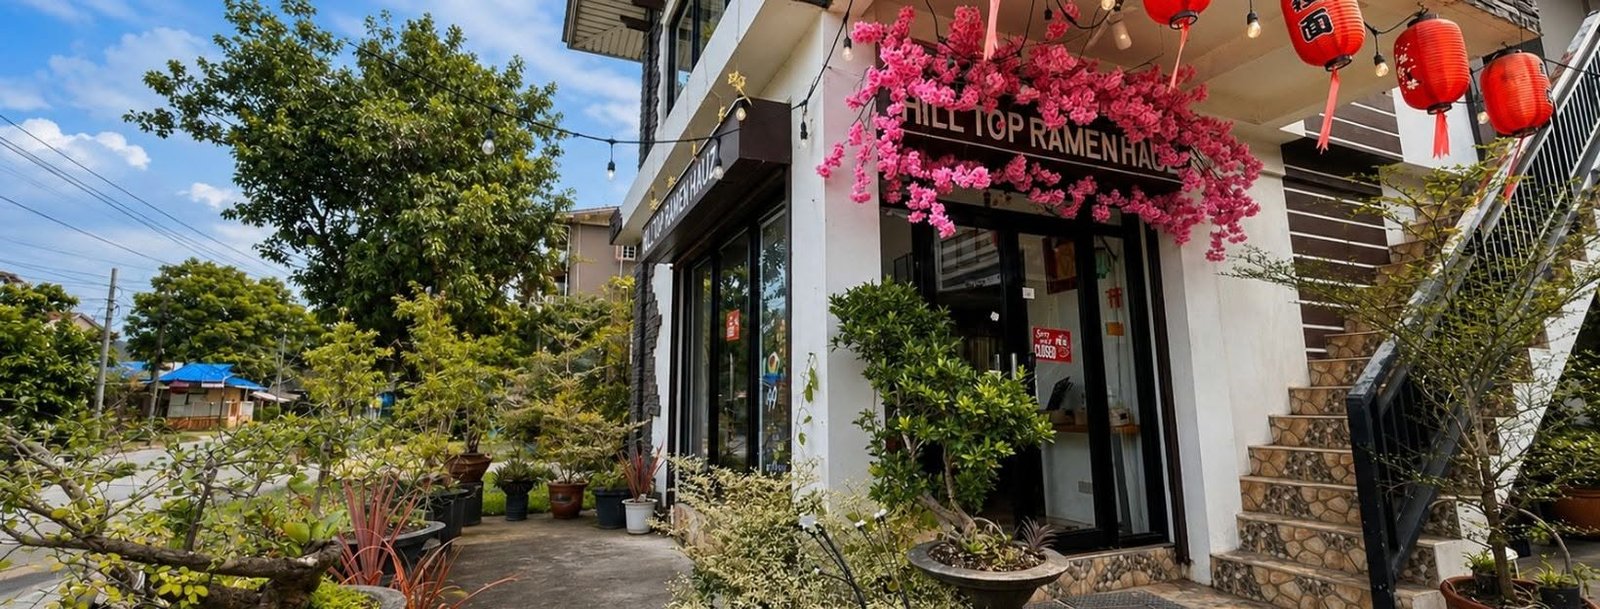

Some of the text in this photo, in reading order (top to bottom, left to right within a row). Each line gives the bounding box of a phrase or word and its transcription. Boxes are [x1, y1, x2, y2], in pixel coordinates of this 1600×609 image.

[903, 98, 1179, 174] HILL TOP RAMEN HAU
[689, 145, 717, 201] HAUZ
[1034, 343, 1056, 359] CLOSED
